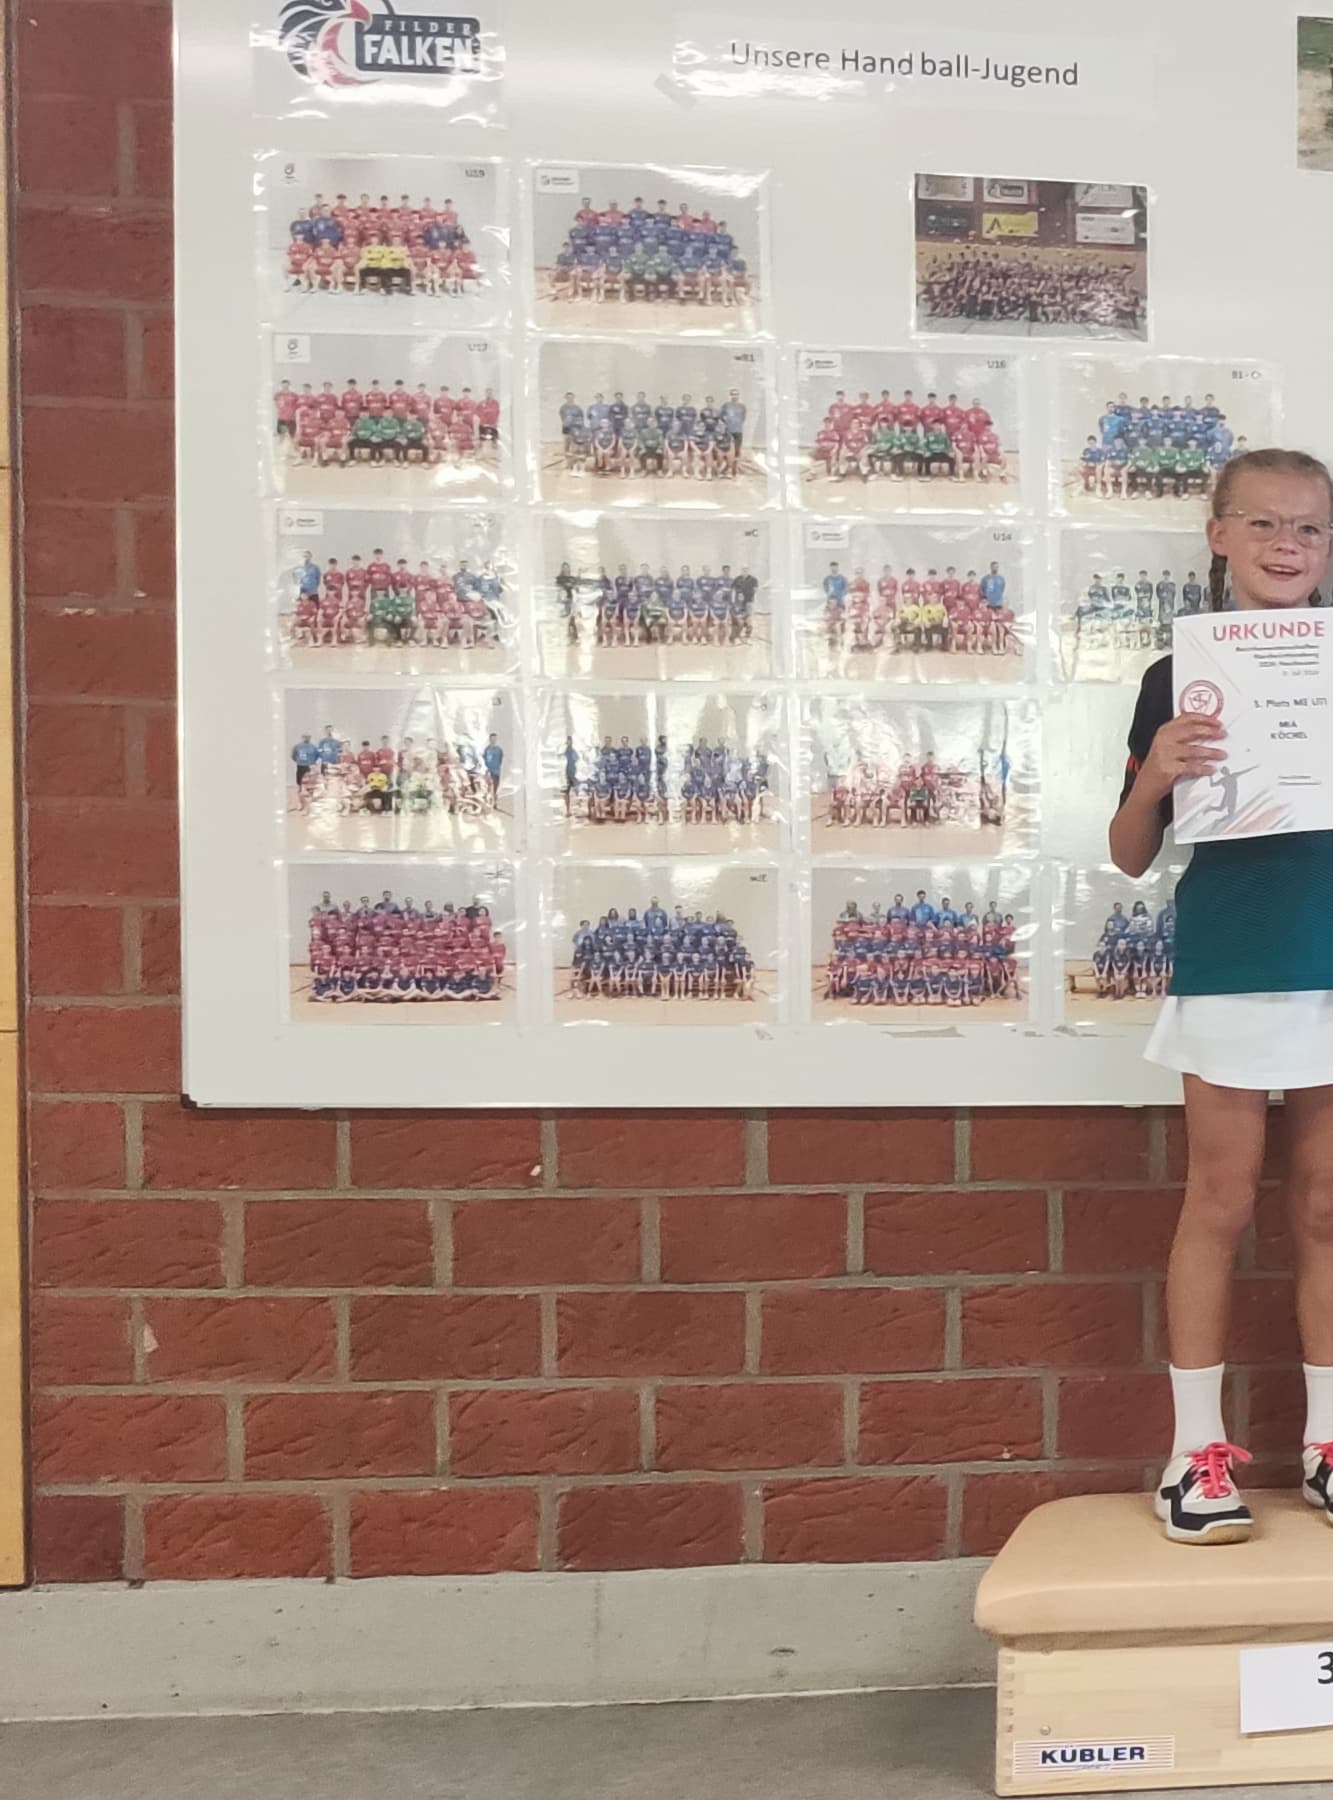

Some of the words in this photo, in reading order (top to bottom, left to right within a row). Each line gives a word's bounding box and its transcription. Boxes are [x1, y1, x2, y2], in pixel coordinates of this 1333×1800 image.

[384, 20, 471, 34] FILDER
[363, 34, 474, 67] FALKEN
[731, 42, 830, 70] Unsere
[1213, 620, 1325, 641] URKUNDE
[1041, 1744, 1145, 1765] KÜBLER
